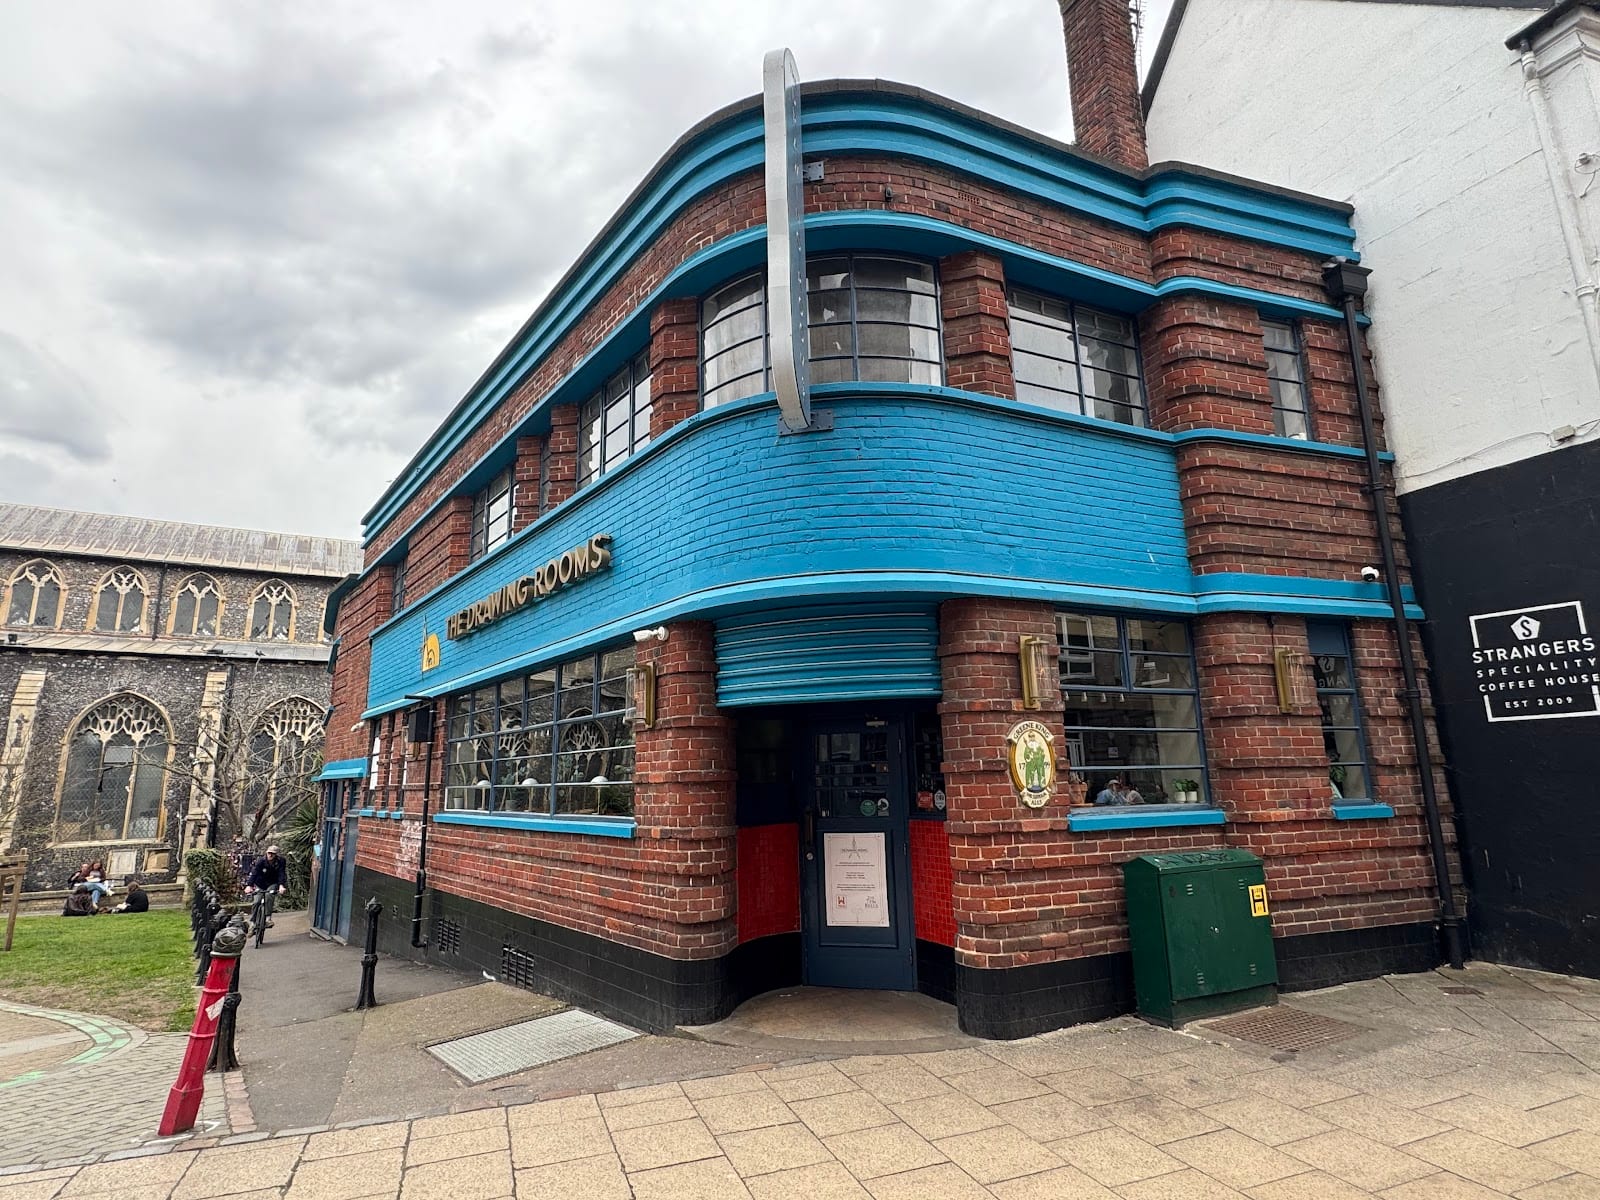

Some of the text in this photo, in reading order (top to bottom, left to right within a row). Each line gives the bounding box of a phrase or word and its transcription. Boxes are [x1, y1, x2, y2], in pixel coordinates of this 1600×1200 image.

[446, 534, 612, 640] THE DRAWING ROOMS
[1472, 637, 1595, 664] STRANGERS
[1476, 657, 1597, 678] SPECIALITY
[1478, 673, 1600, 692] COFFEE HOUSE
[1504, 696, 1573, 709] EST 2009
[1013, 722, 1050, 740] GREENE KING
[1251, 887, 1266, 914] H
